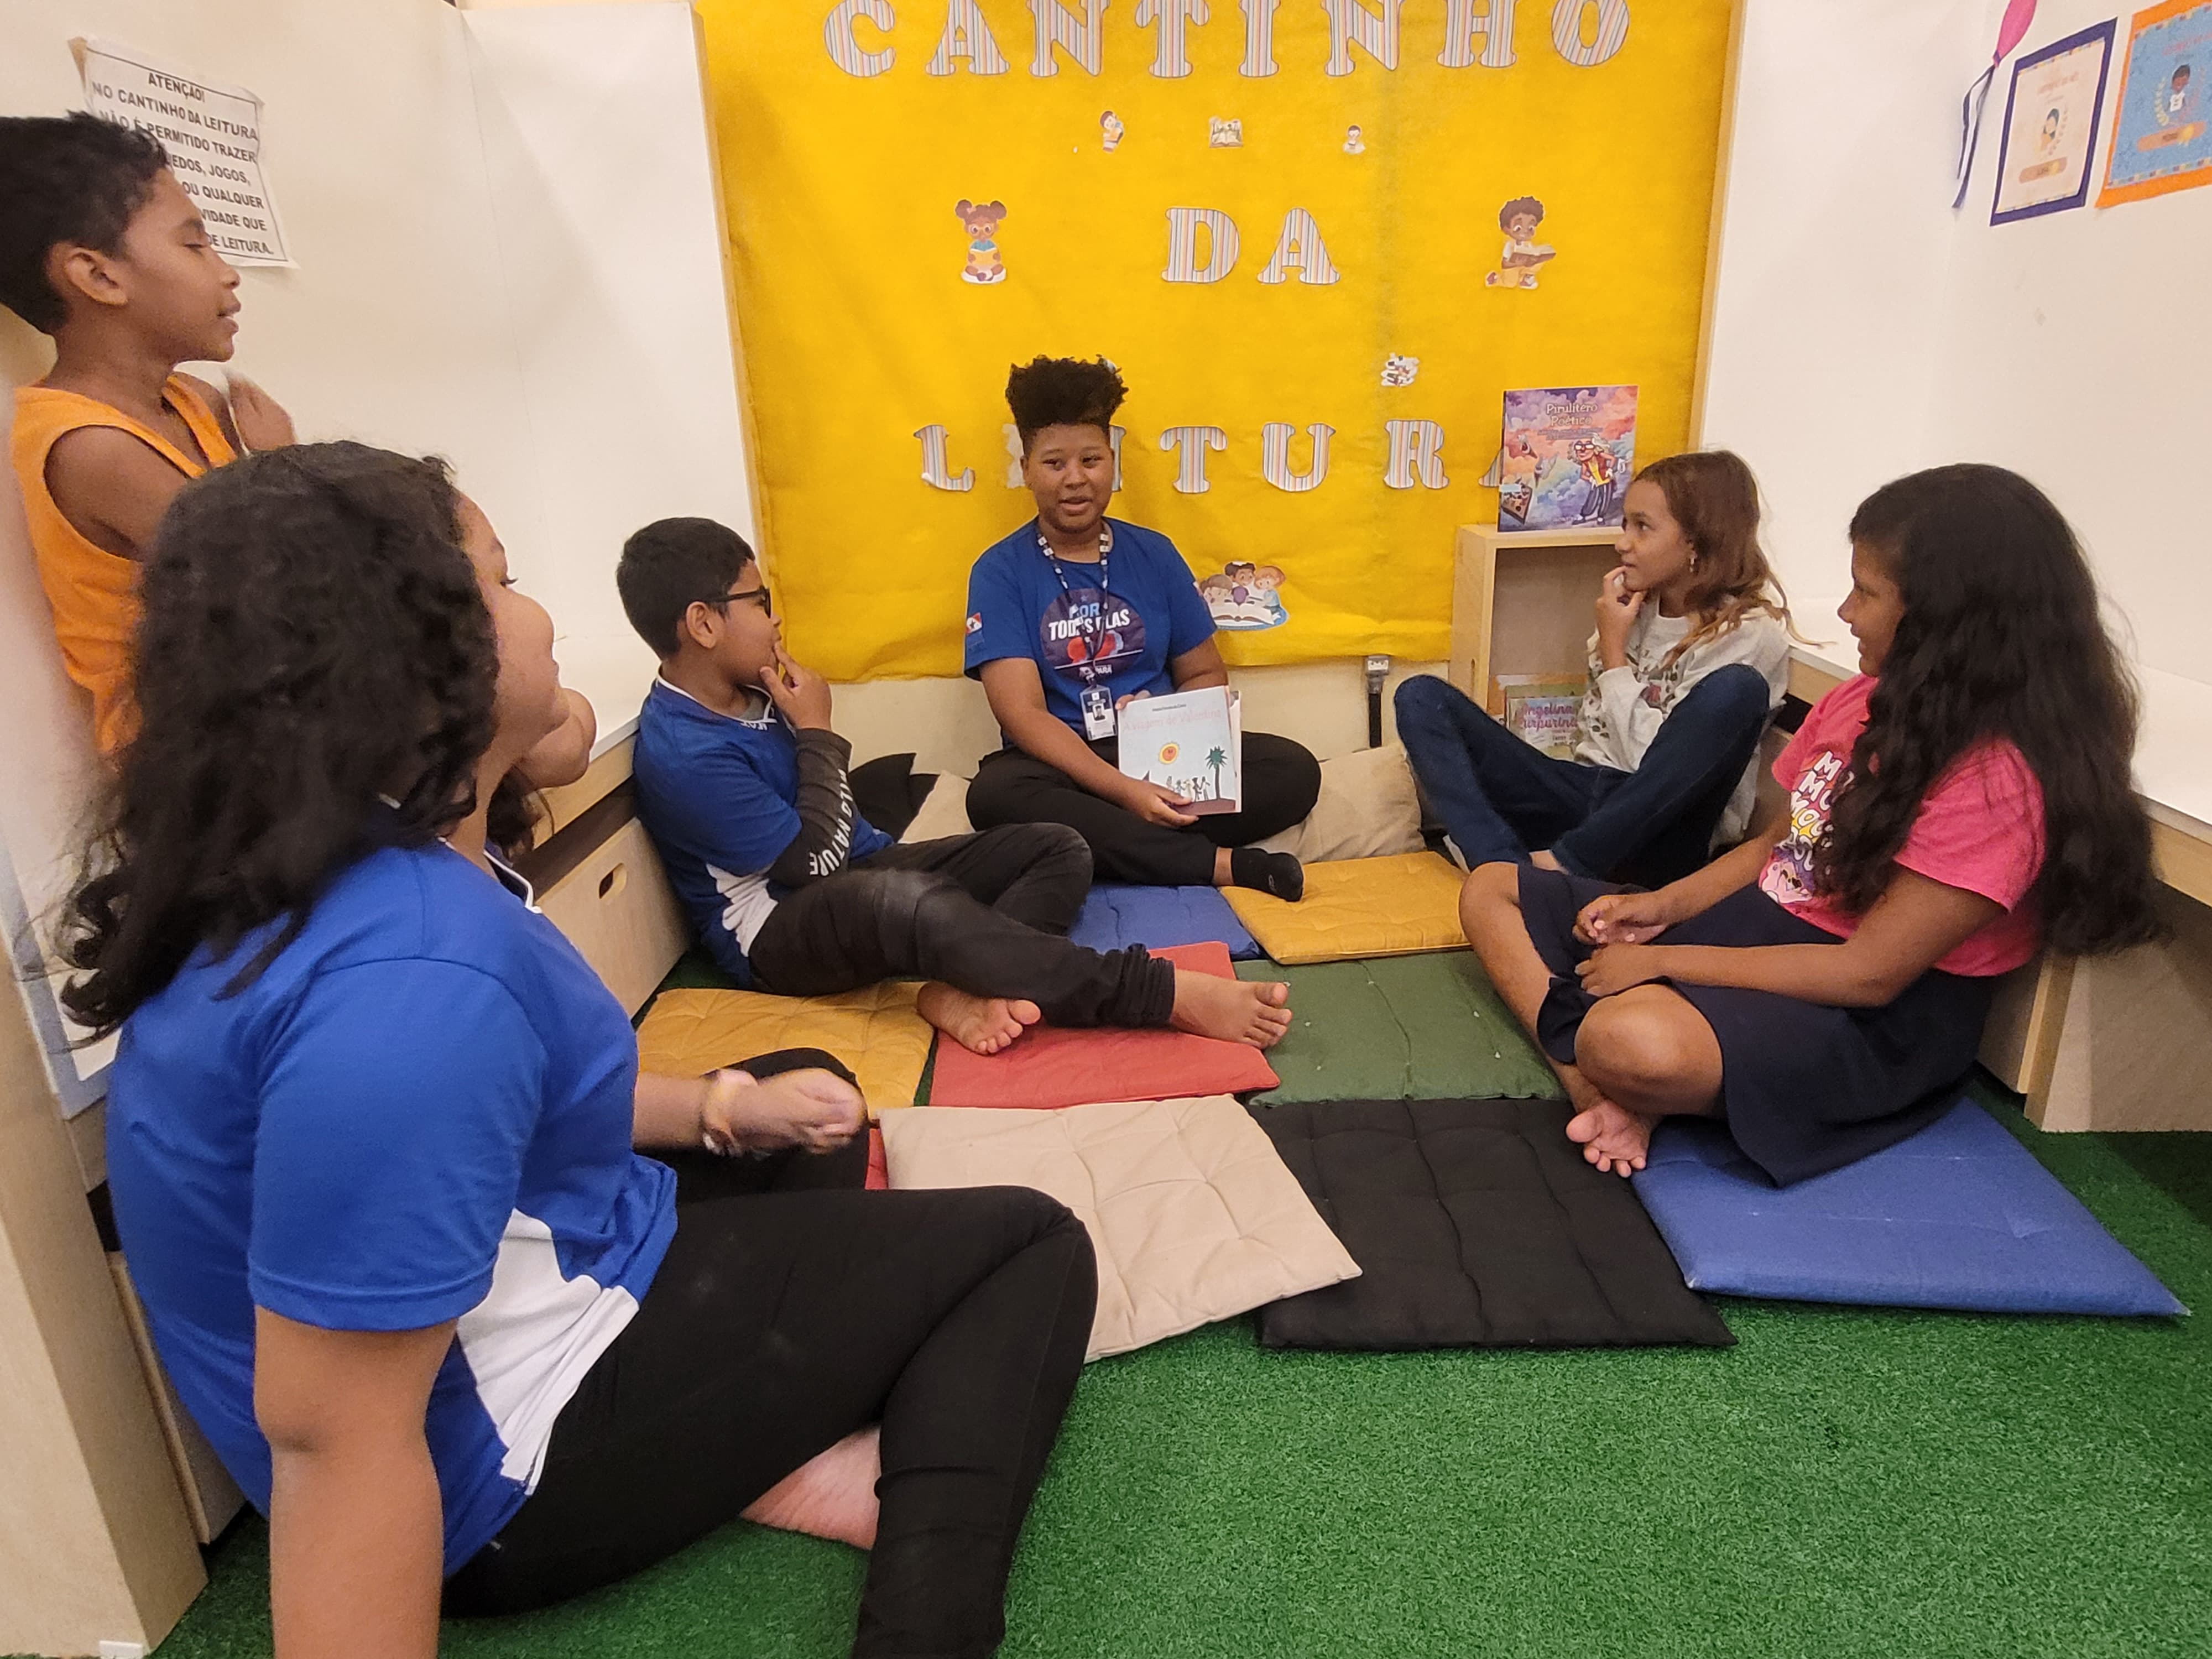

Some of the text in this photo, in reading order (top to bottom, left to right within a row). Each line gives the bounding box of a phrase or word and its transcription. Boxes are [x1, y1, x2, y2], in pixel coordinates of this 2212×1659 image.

[823, 0, 1630, 77] CANTINHO
[92, 81, 259, 141] NO CANTINHO DA LEITURA
[147, 123, 210, 151] PERMITIDO
[212, 141, 258, 165] TRAZER
[172, 154, 251, 186] EDOS, JOGOS,
[182, 181, 264, 209] OU QUALQUER
[200, 208, 268, 231] VIDADE QUE
[222, 235, 274, 254] LEITURA.
[1161, 207, 1340, 285] DA
[1546, 402, 1598, 414] Pirulitero
[913, 419, 1503, 494] LTUR
[810, 818, 851, 877] NATURE
